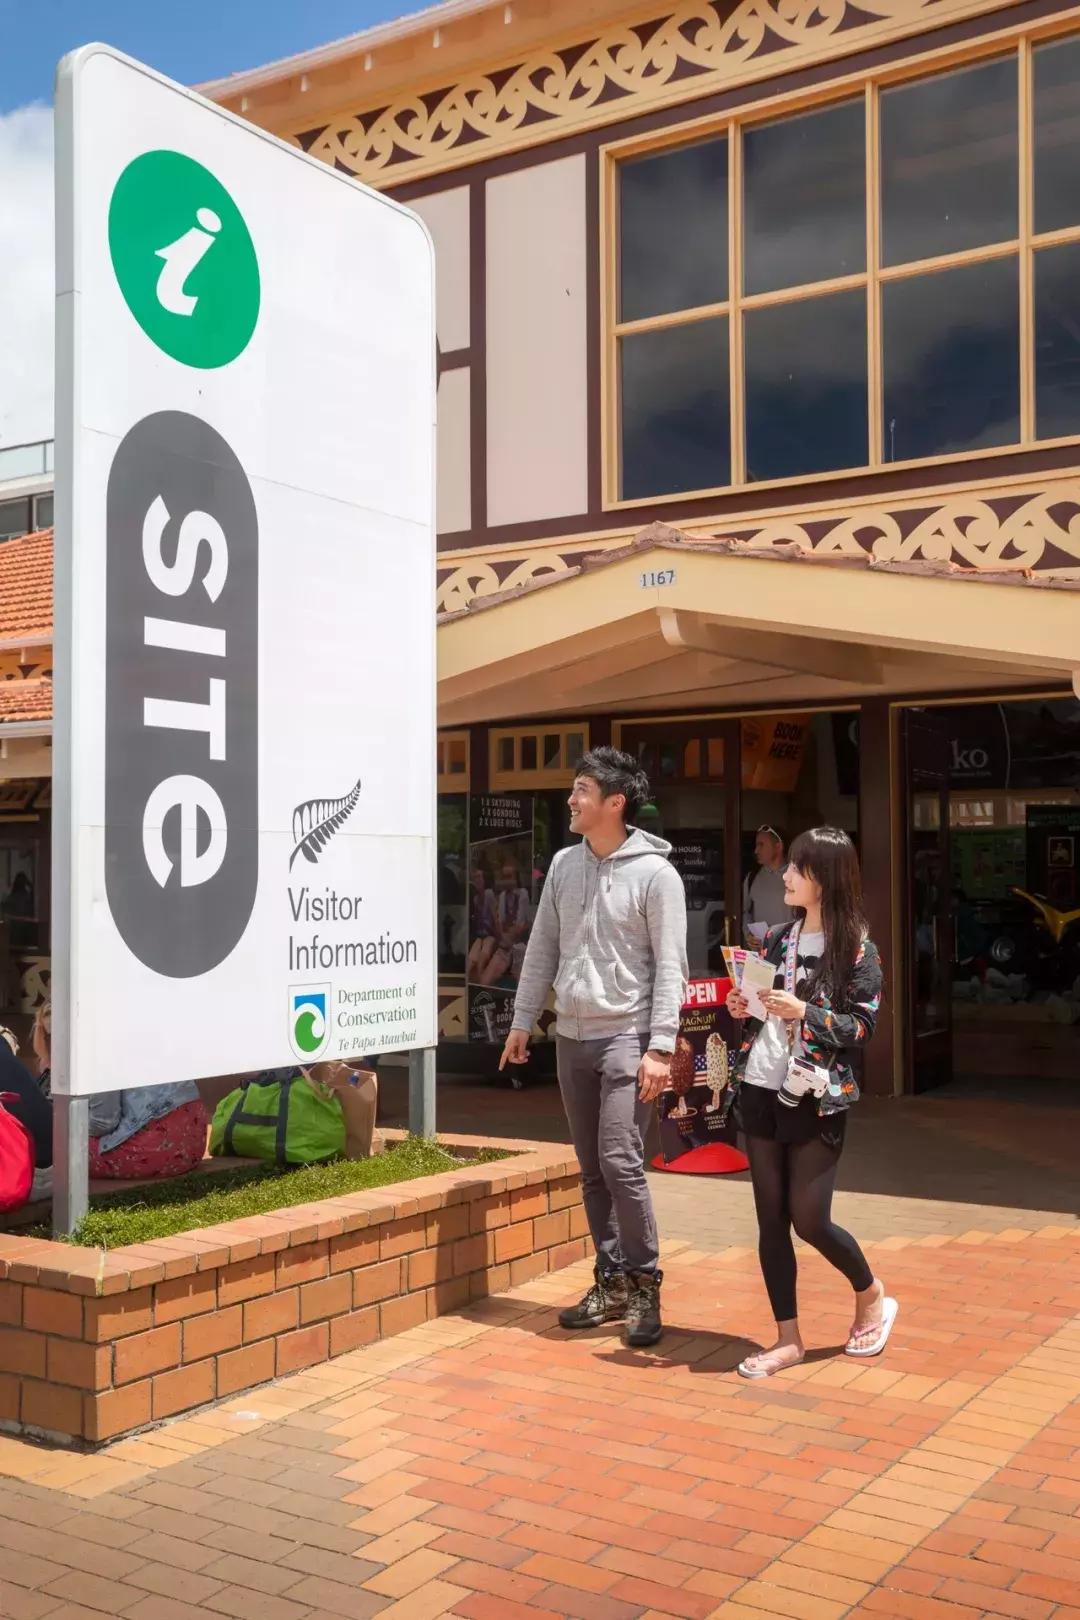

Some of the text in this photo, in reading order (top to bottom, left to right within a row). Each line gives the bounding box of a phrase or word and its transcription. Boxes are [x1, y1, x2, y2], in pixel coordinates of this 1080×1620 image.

[642, 570, 674, 587] 1167
[768, 740, 801, 760] HERE
[493, 808, 520, 818] GONDOLA
[287, 887, 363, 922] Visitor
[289, 931, 417, 971] Information
[338, 982, 417, 1006] Department of
[337, 1006, 417, 1028] Conservation
[339, 1038, 350, 1051] Te
[351, 1036, 376, 1051] Papa
